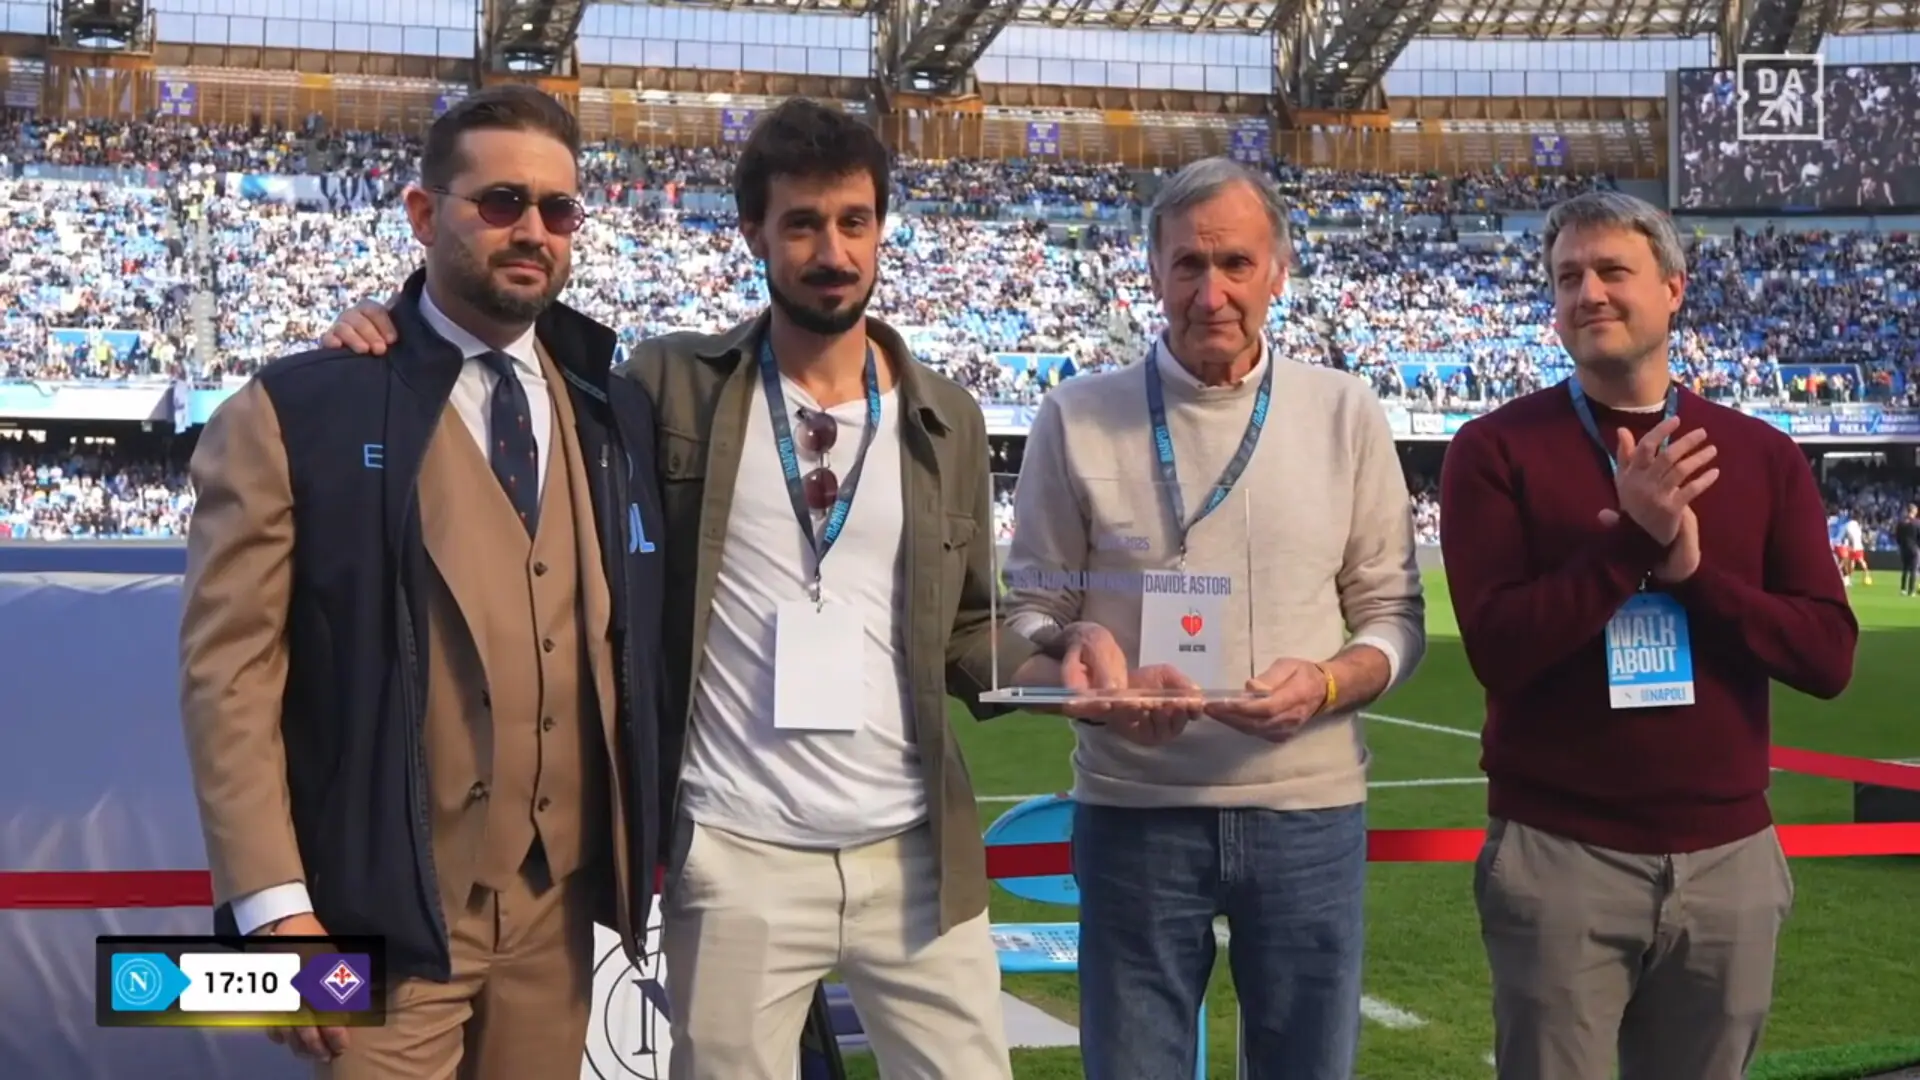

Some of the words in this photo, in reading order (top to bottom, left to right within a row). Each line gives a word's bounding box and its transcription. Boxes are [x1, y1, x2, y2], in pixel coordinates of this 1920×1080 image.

[1145, 573, 1187, 595] DAVIDE
[1189, 575, 1232, 597] ASTORI
[1609, 616, 1676, 646] WALK
[1613, 646, 1677, 673] ABOUT
